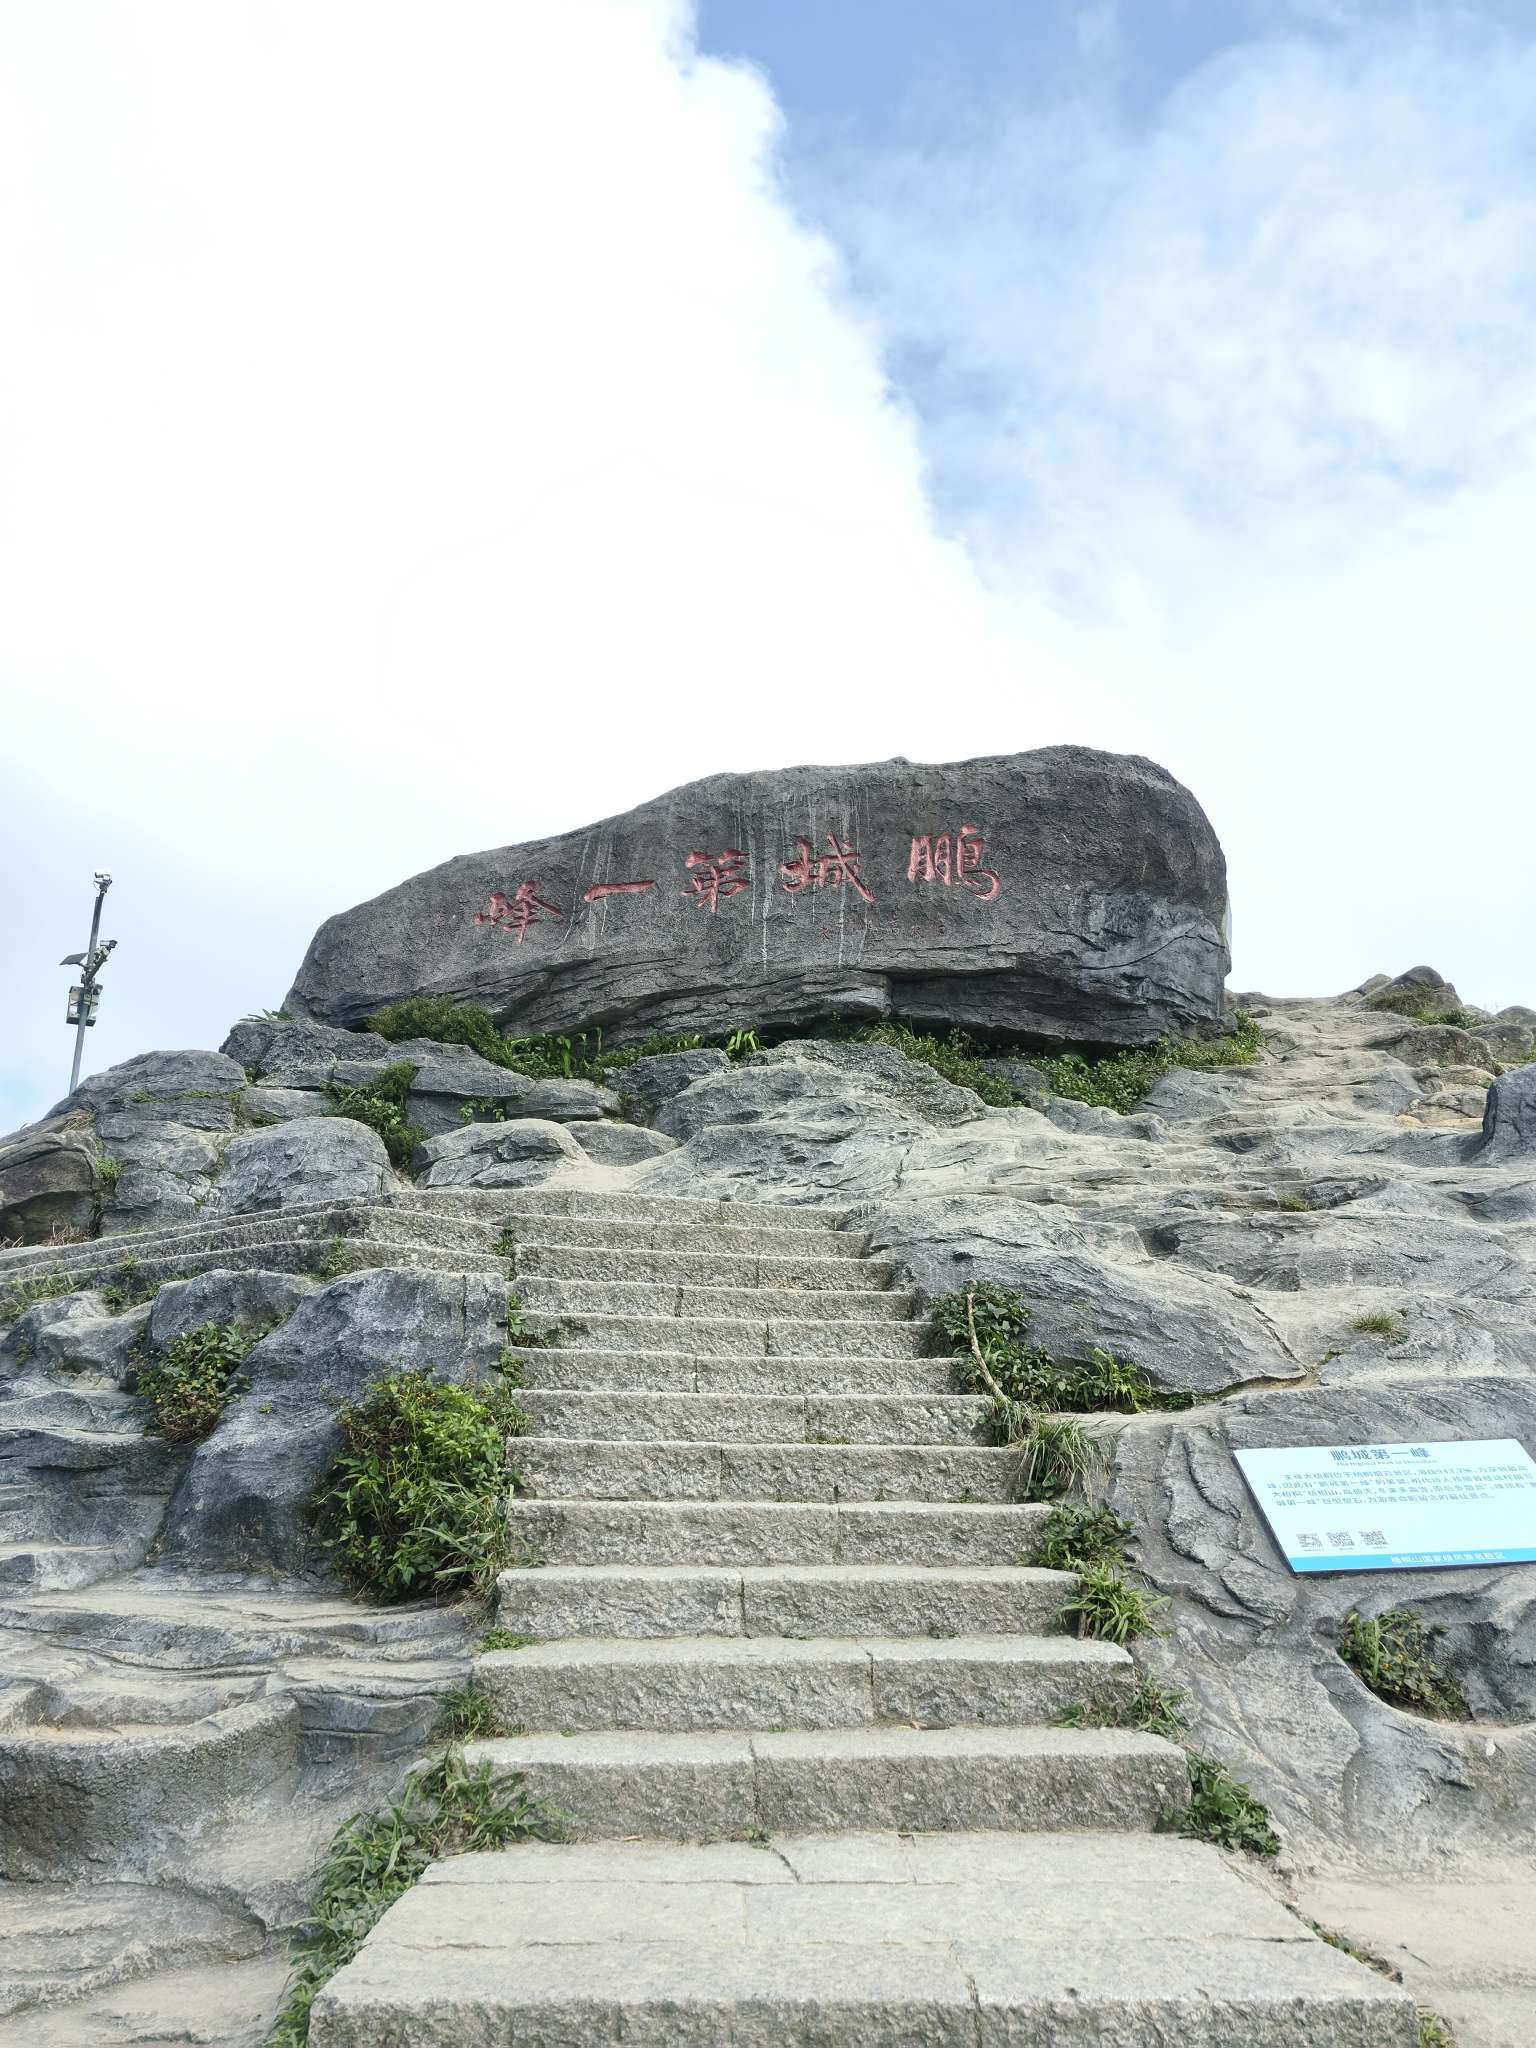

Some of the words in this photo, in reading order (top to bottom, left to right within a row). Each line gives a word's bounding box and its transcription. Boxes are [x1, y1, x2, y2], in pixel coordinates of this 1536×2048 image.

[1329, 1447, 1430, 1461] 鹏城第一峰
